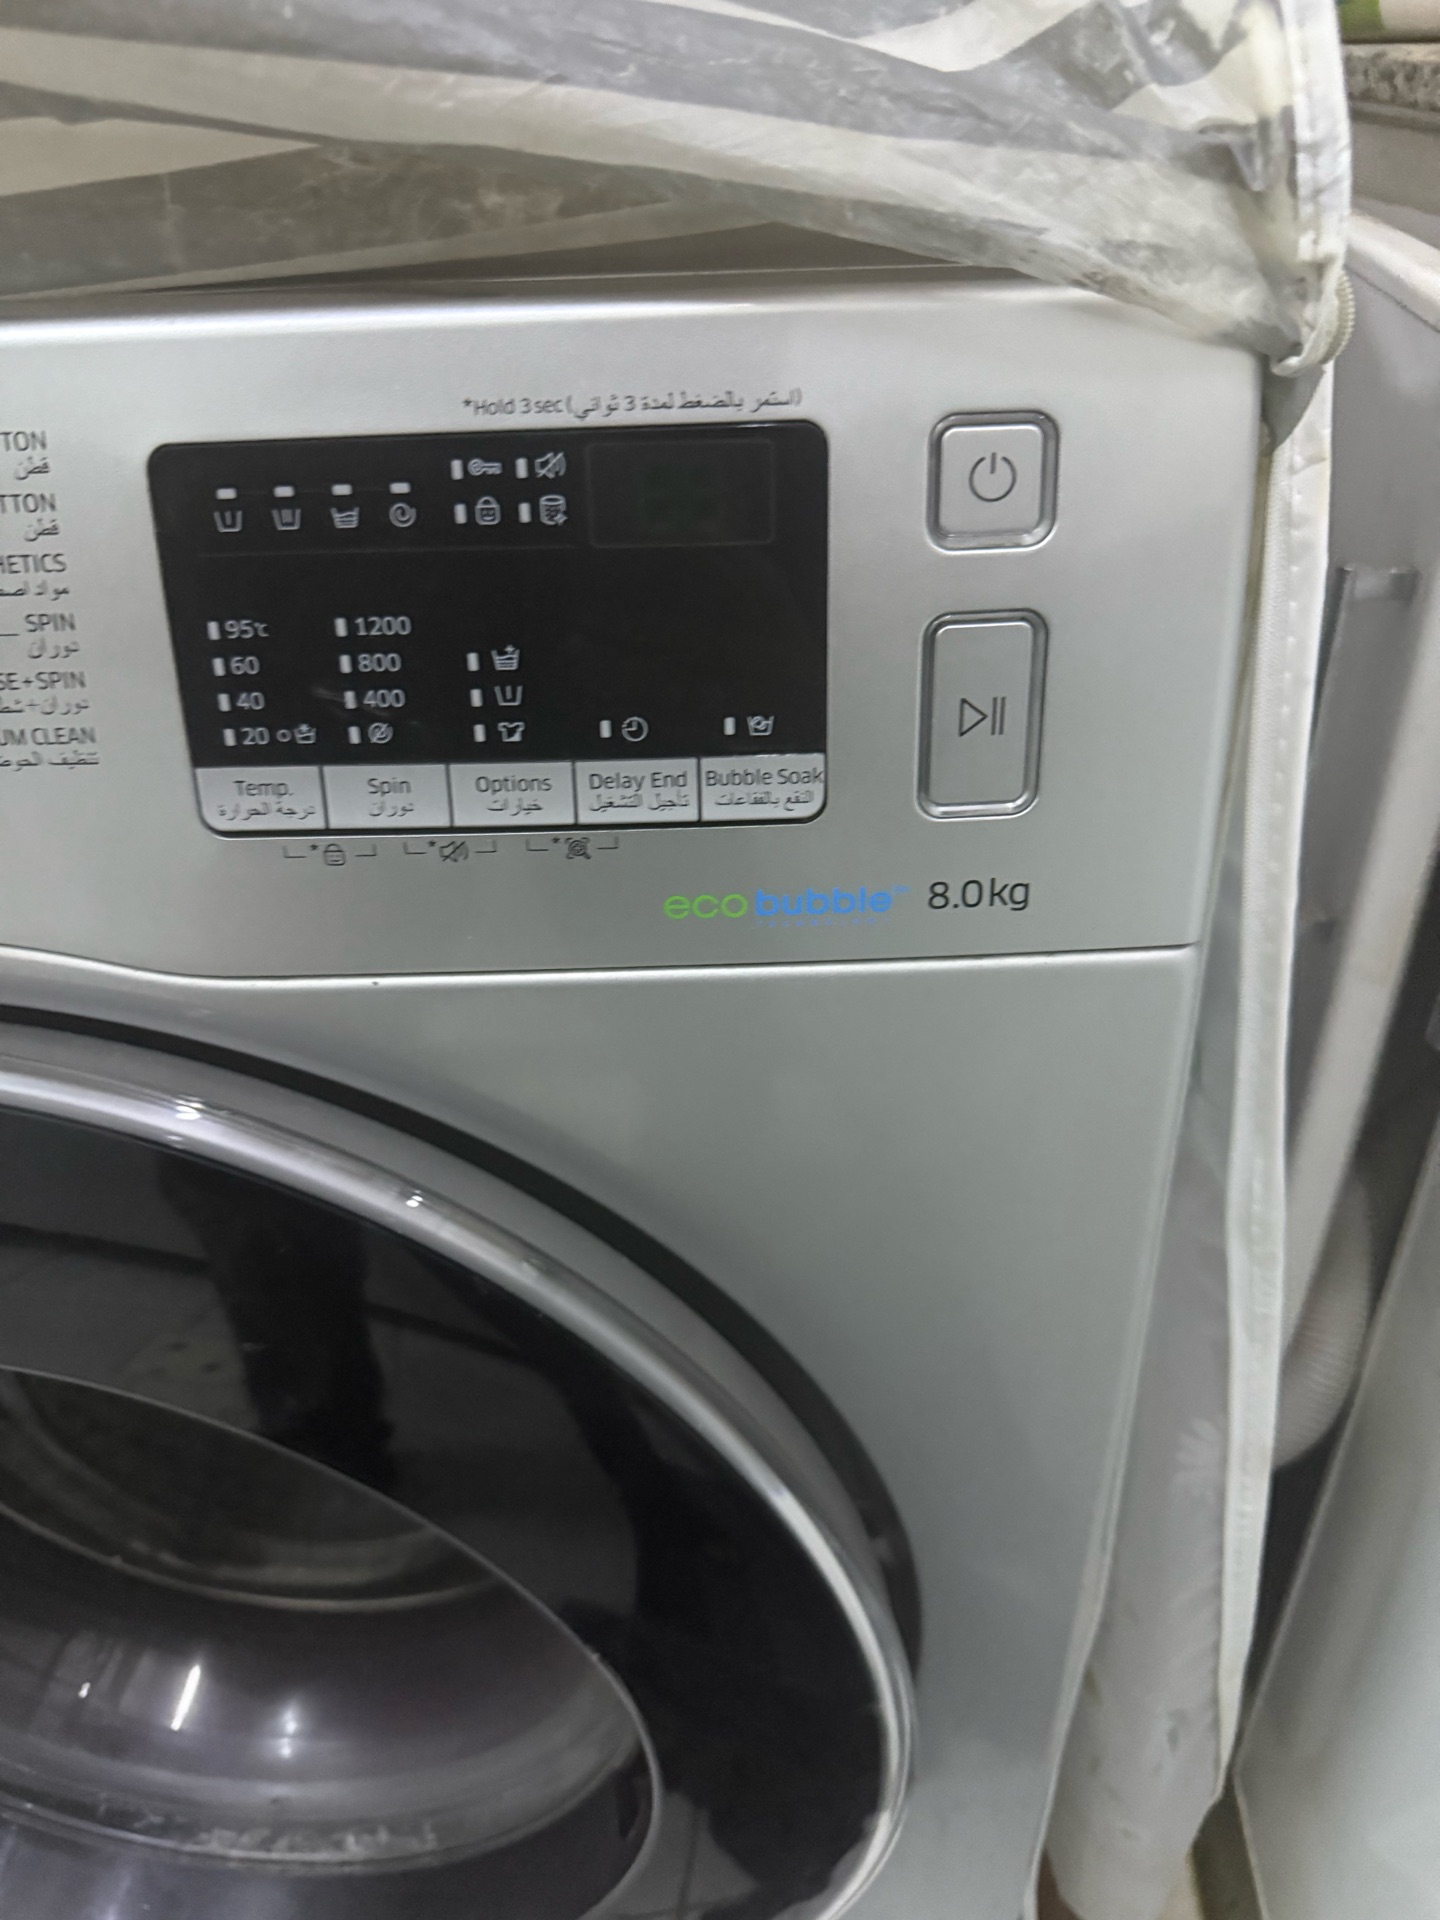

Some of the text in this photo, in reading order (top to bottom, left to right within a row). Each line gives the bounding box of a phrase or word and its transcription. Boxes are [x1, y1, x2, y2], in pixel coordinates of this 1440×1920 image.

[624, 395, 636, 411] 3
[0, 430, 47, 452] TON
[25, 613, 76, 632] SPIN
[354, 616, 413, 637] 1200
[230, 656, 261, 675] 60
[357, 653, 401, 673] 800
[236, 692, 265, 711] 40
[362, 689, 406, 708] 400
[31, 727, 97, 746] CLEAN
[241, 727, 271, 746] 20
[367, 777, 412, 797] Spin
[475, 774, 553, 795] Options
[588, 770, 688, 791] Delay End
[705, 767, 825, 787] Bubble Soak
[663, 885, 894, 921] eco bubble
